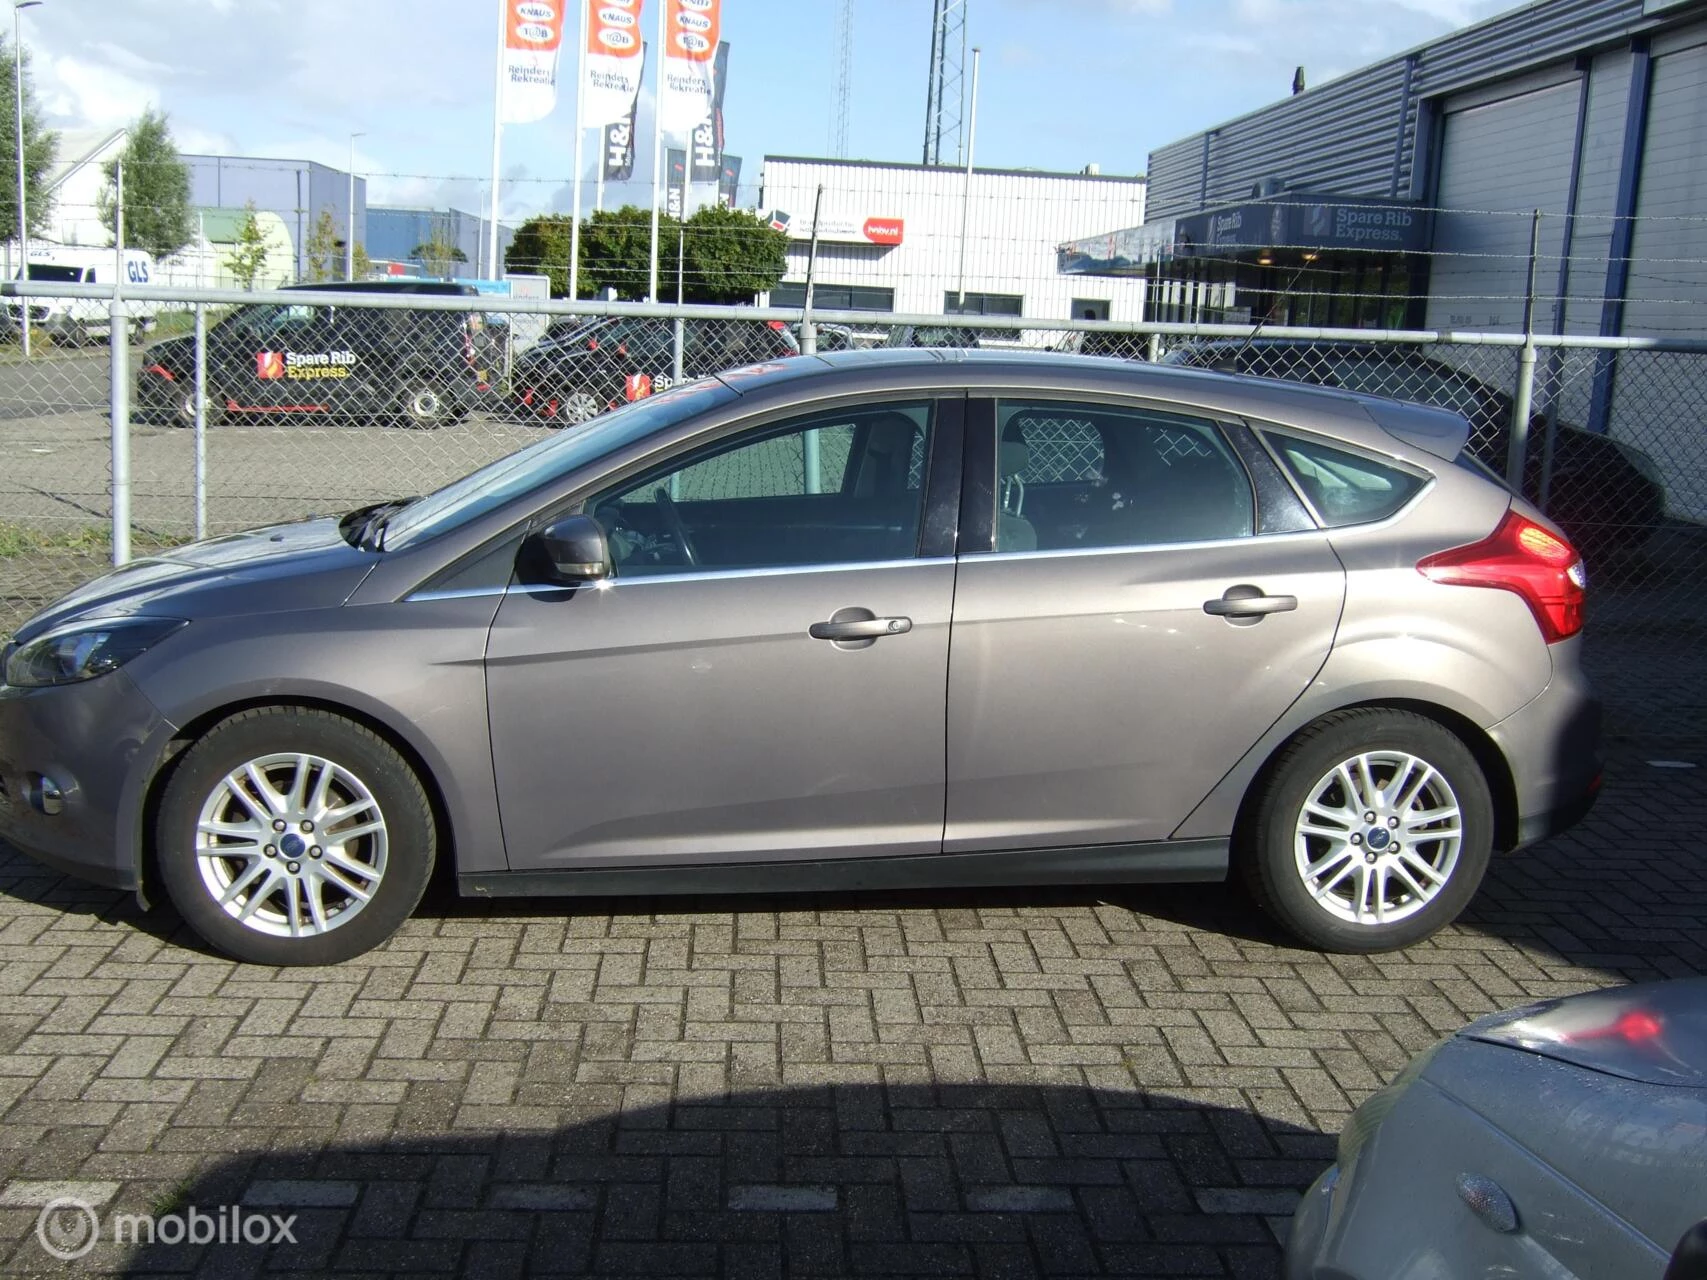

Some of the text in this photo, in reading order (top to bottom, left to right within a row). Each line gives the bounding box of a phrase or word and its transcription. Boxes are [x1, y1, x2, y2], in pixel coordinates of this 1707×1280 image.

[520, 7, 552, 18] KNAUS
[602, 13, 633, 24] KNAUS
[679, 15, 709, 28] KNAUS
[1336, 207, 1412, 226] Spare Rib
[128, 260, 149, 283] GLS
[286, 350, 356, 367] Spare Rib
